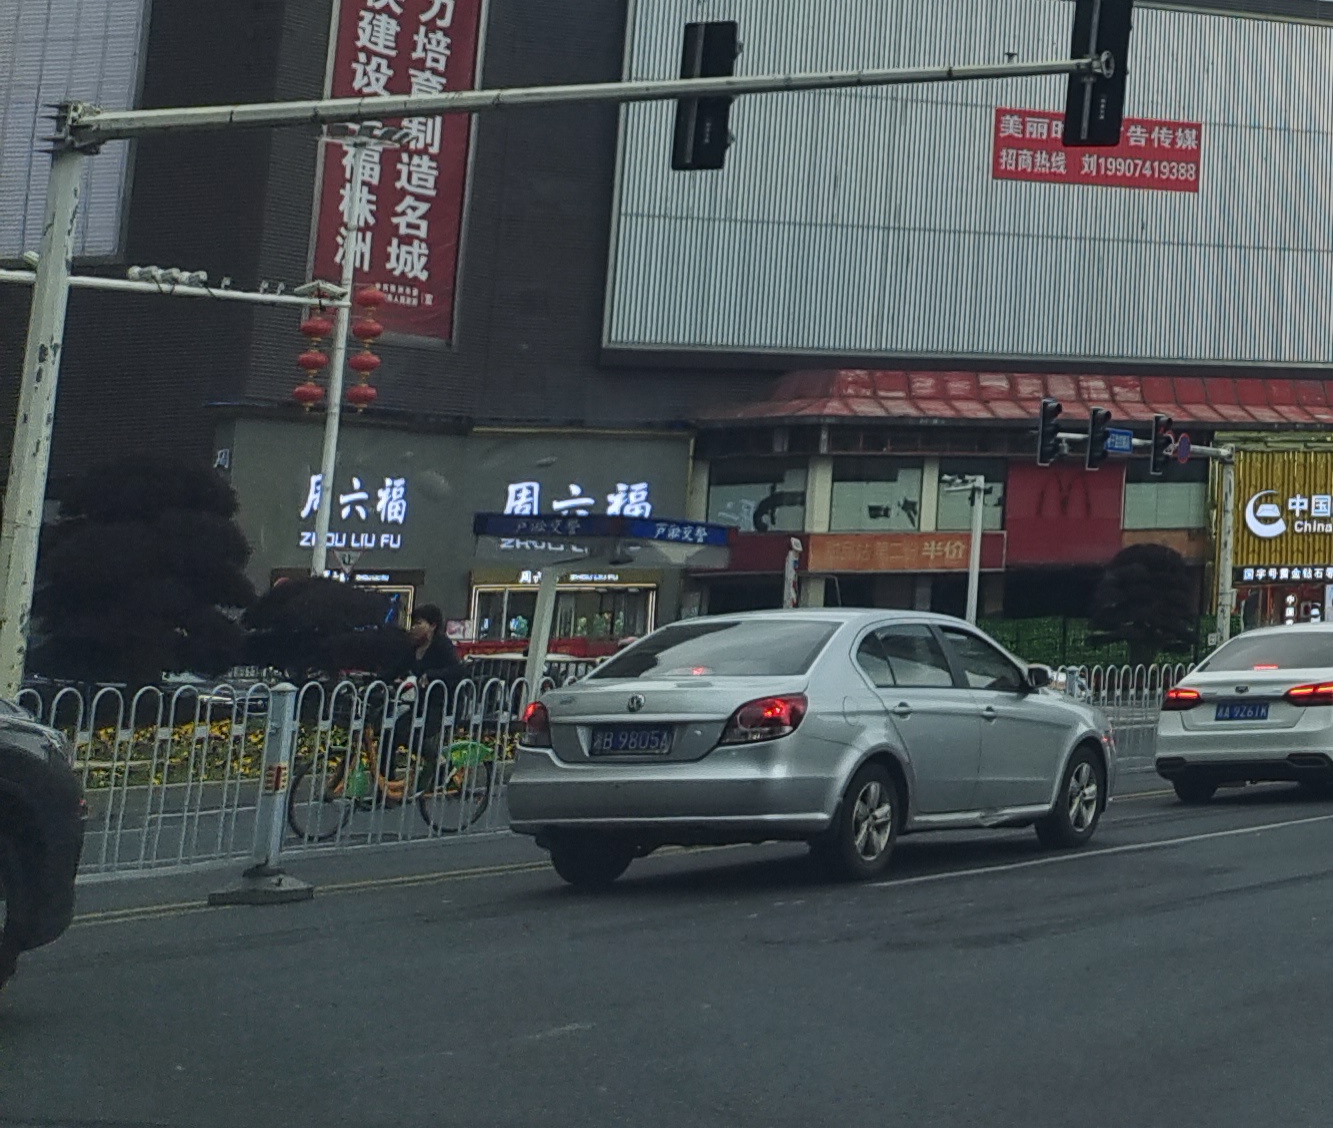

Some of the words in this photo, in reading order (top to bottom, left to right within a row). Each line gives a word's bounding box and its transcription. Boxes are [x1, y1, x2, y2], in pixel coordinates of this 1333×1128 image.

[1000, 148, 1067, 175] 招商热线
[1080, 154, 1197, 181] 刘19907419388
[503, 481, 652, 519] 周六福
[1293, 520, 1333, 534] China
[351, 532, 376, 548] LIU
[380, 532, 402, 549] FU
